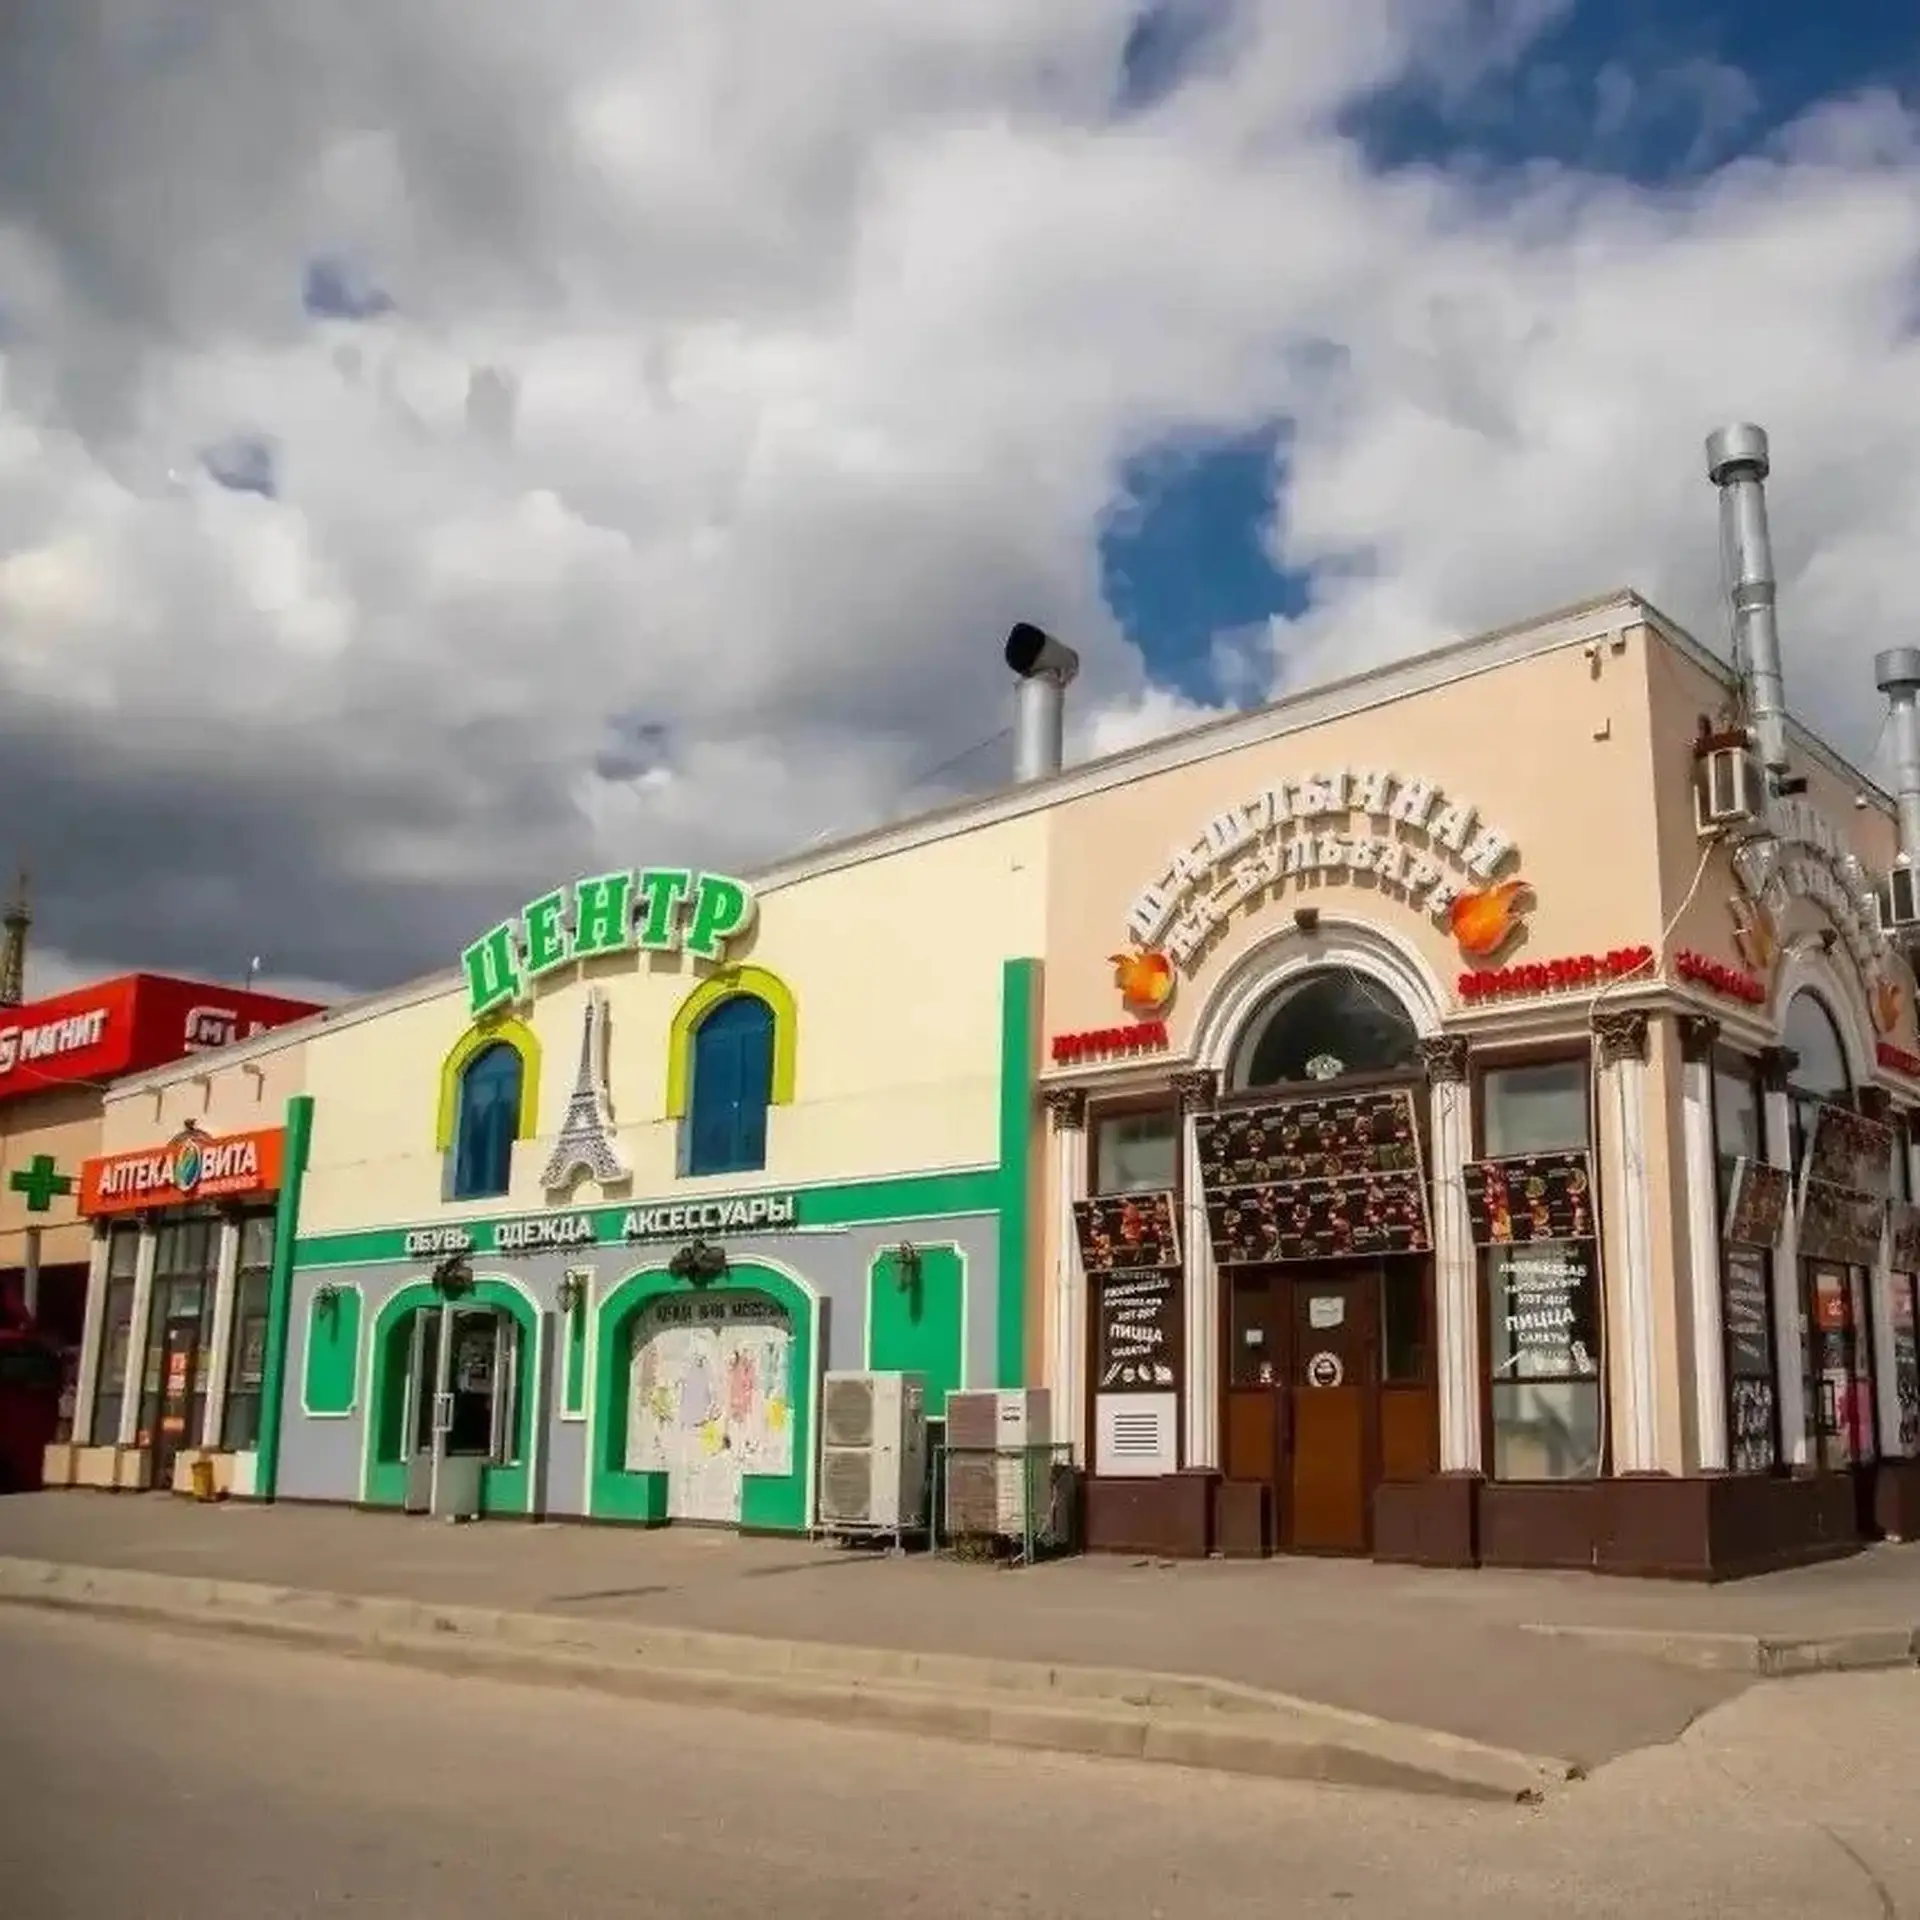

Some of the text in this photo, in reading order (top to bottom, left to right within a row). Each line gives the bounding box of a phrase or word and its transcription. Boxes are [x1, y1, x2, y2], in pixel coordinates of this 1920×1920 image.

[1125, 772, 1512, 944] ШАШЛЫЧНАЯ
[461, 868, 753, 1018] ЦЕНТР
[20, 1008, 107, 1061] МАГНИТ
[97, 1152, 175, 1196] АПТЕКА
[200, 1139, 258, 1179] ВИТА
[405, 1195, 794, 1252] ОБУВЬ ОДЕЖДА АКСЕССУАРЫ
[1109, 1322, 1163, 1342] ПИЦЦА
[1505, 1308, 1576, 1332] ПИЦЦА
